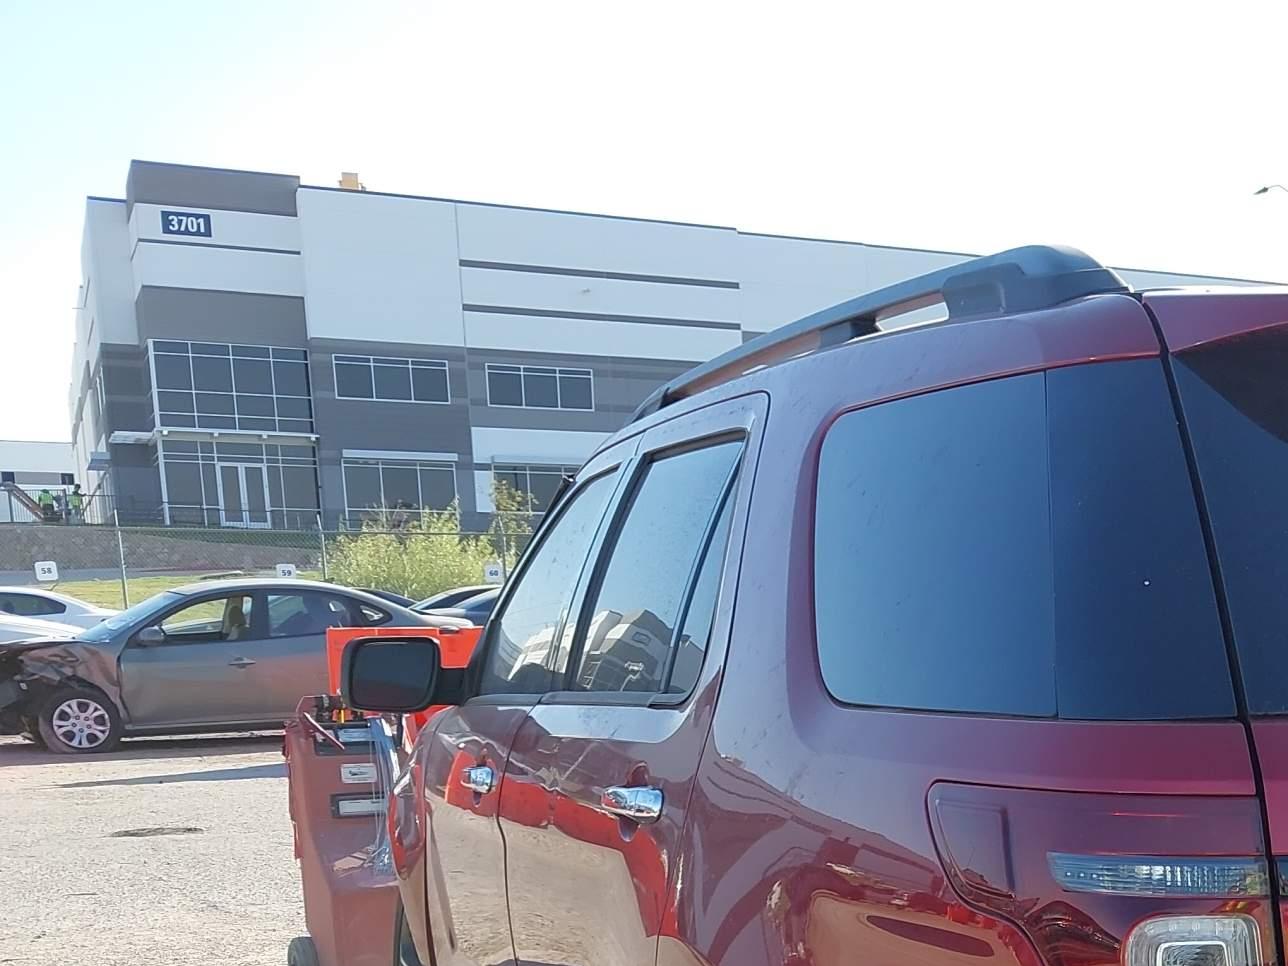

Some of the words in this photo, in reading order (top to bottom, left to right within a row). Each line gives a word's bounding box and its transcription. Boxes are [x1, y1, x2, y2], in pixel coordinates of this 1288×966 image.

[168, 215, 205, 233] 3701
[40, 567, 53, 575] 58
[281, 569, 292, 577] 59
